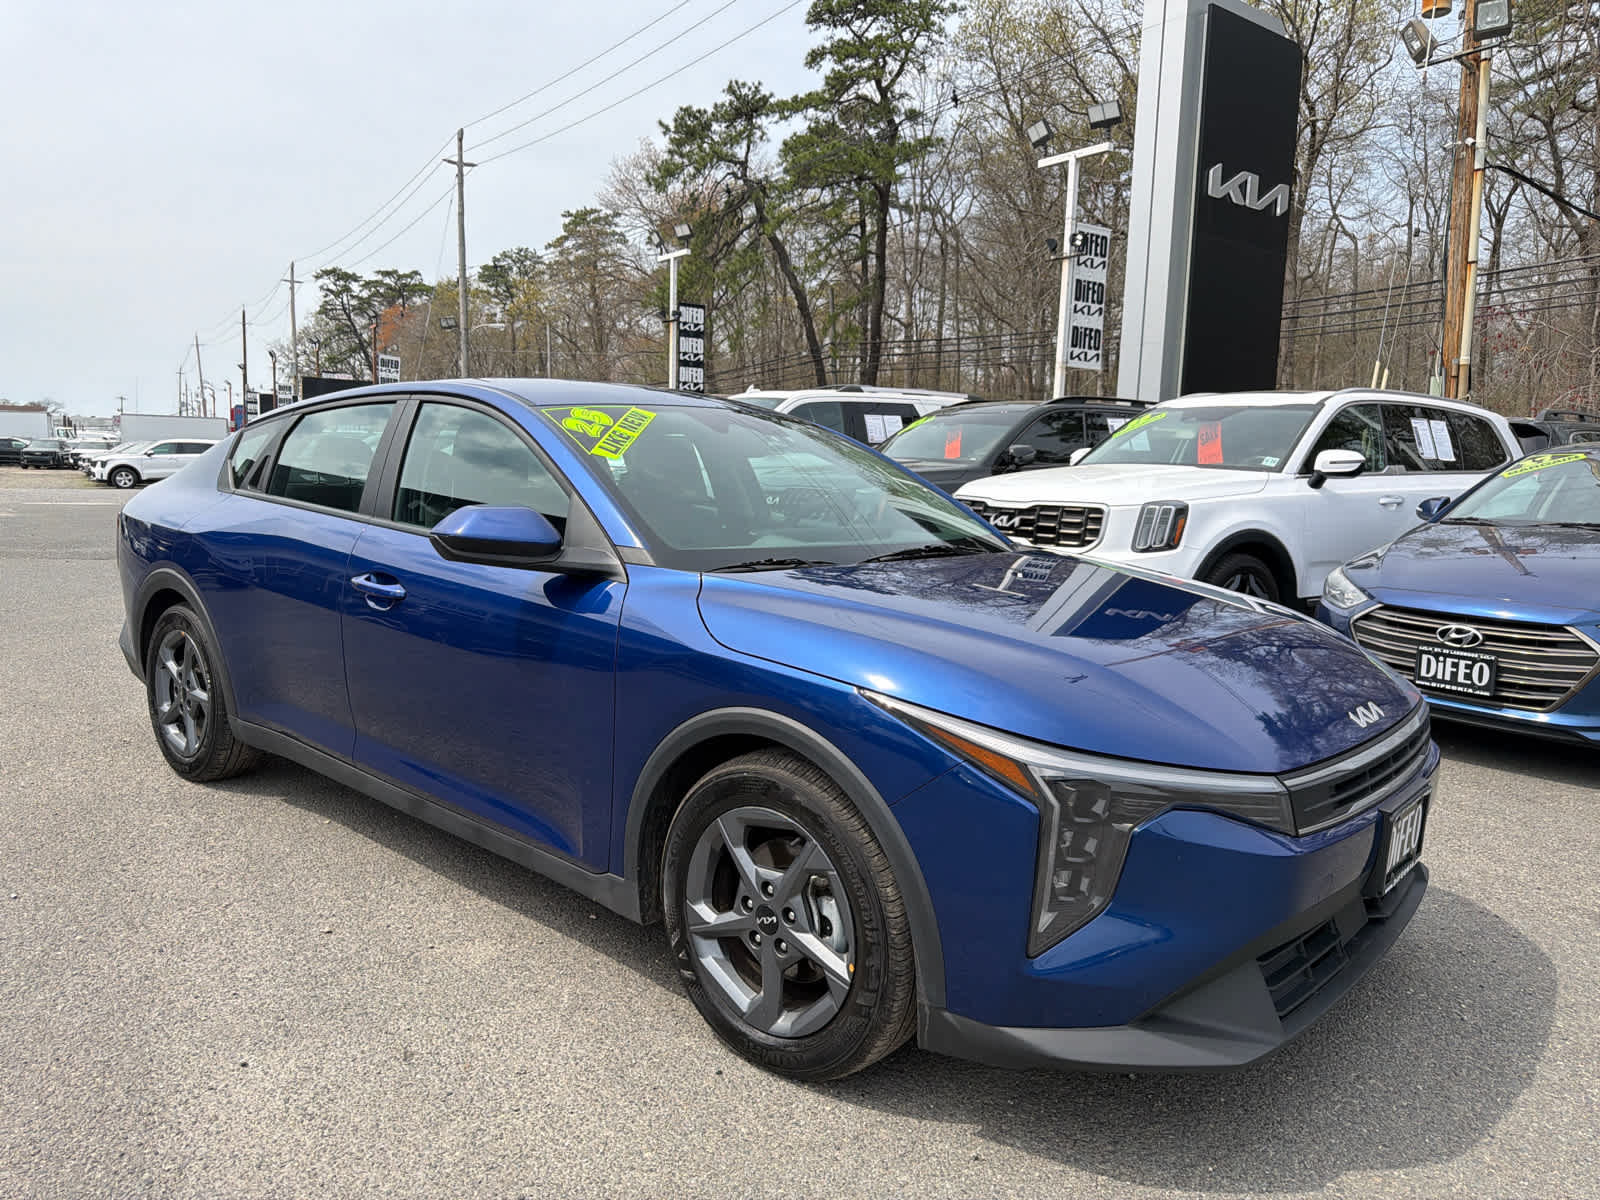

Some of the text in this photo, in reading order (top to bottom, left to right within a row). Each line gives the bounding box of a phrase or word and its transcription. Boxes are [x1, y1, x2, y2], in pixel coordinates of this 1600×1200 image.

[1208, 163, 1289, 216] KIA
[598, 410, 651, 455] LIKE NEW
[1420, 653, 1490, 686] DiFEO
